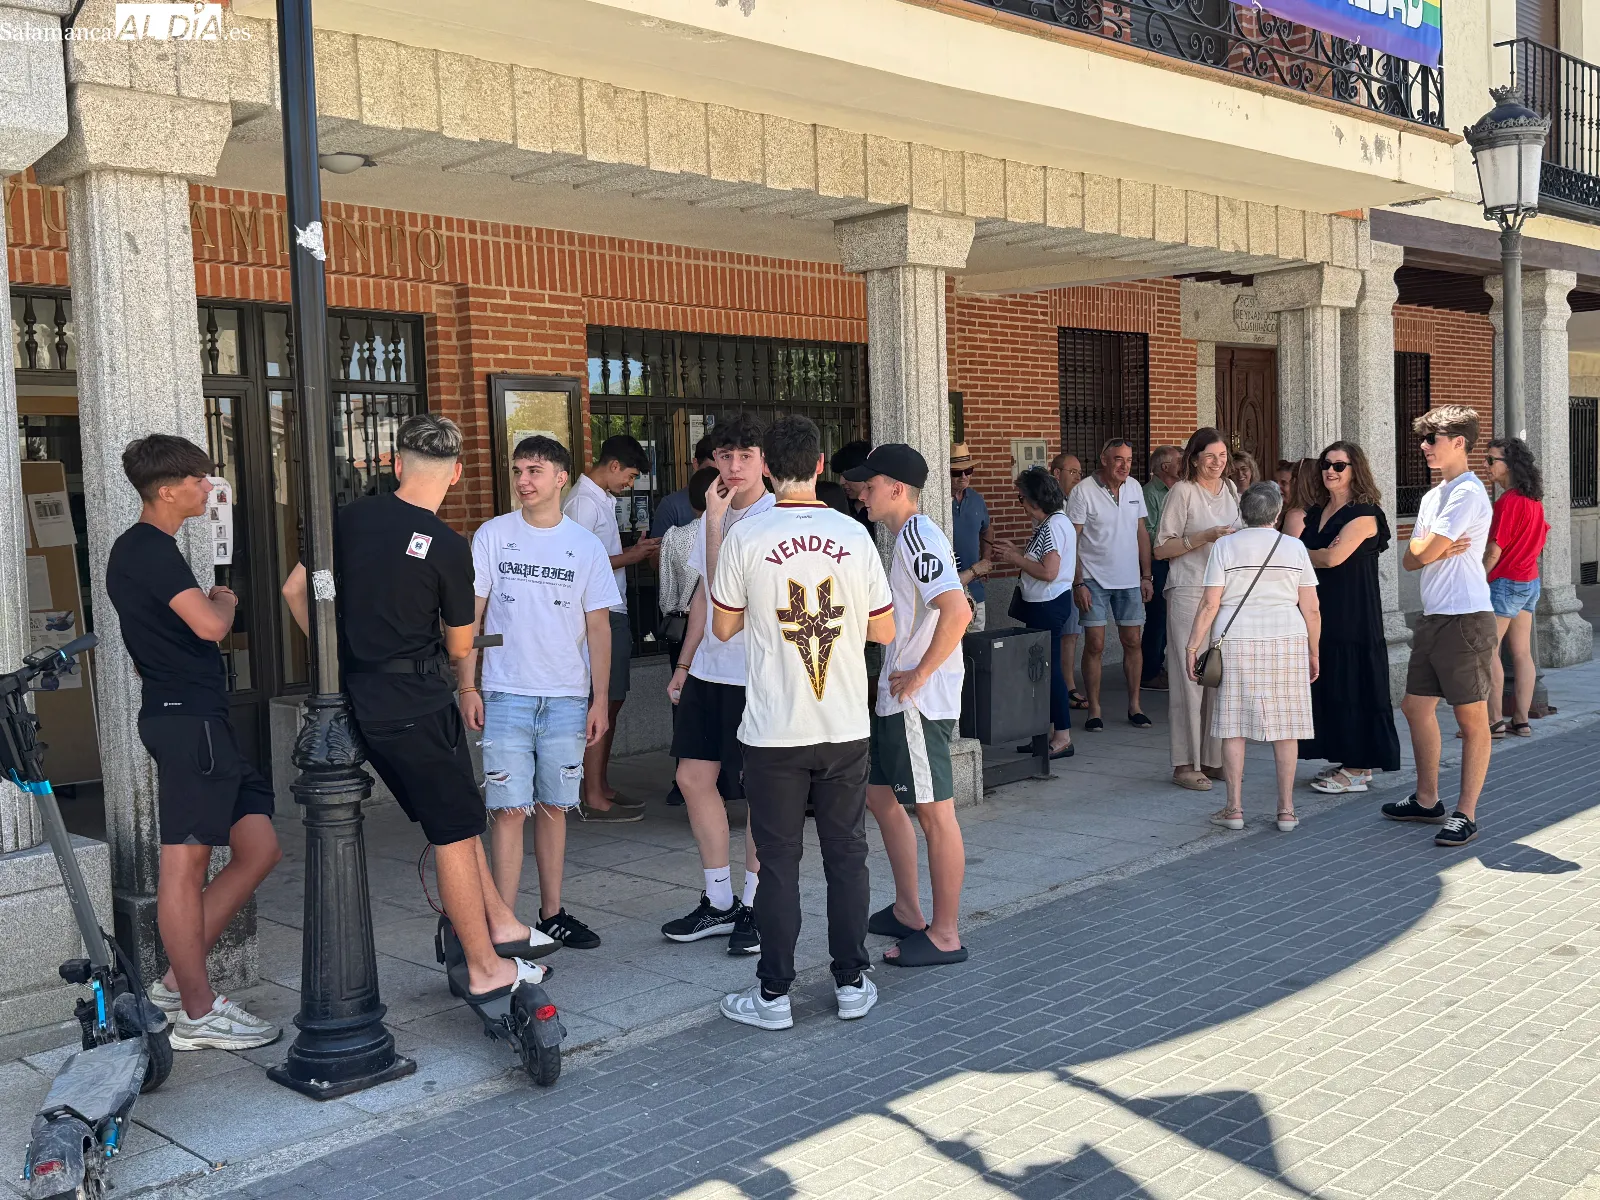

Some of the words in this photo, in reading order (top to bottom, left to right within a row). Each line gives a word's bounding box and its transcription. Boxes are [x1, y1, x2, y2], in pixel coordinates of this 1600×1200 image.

[764, 535, 852, 565] VENDEX
[498, 561, 540, 578] CARPE
[541, 566, 575, 582] DIEM
[918, 552, 939, 582] hp
